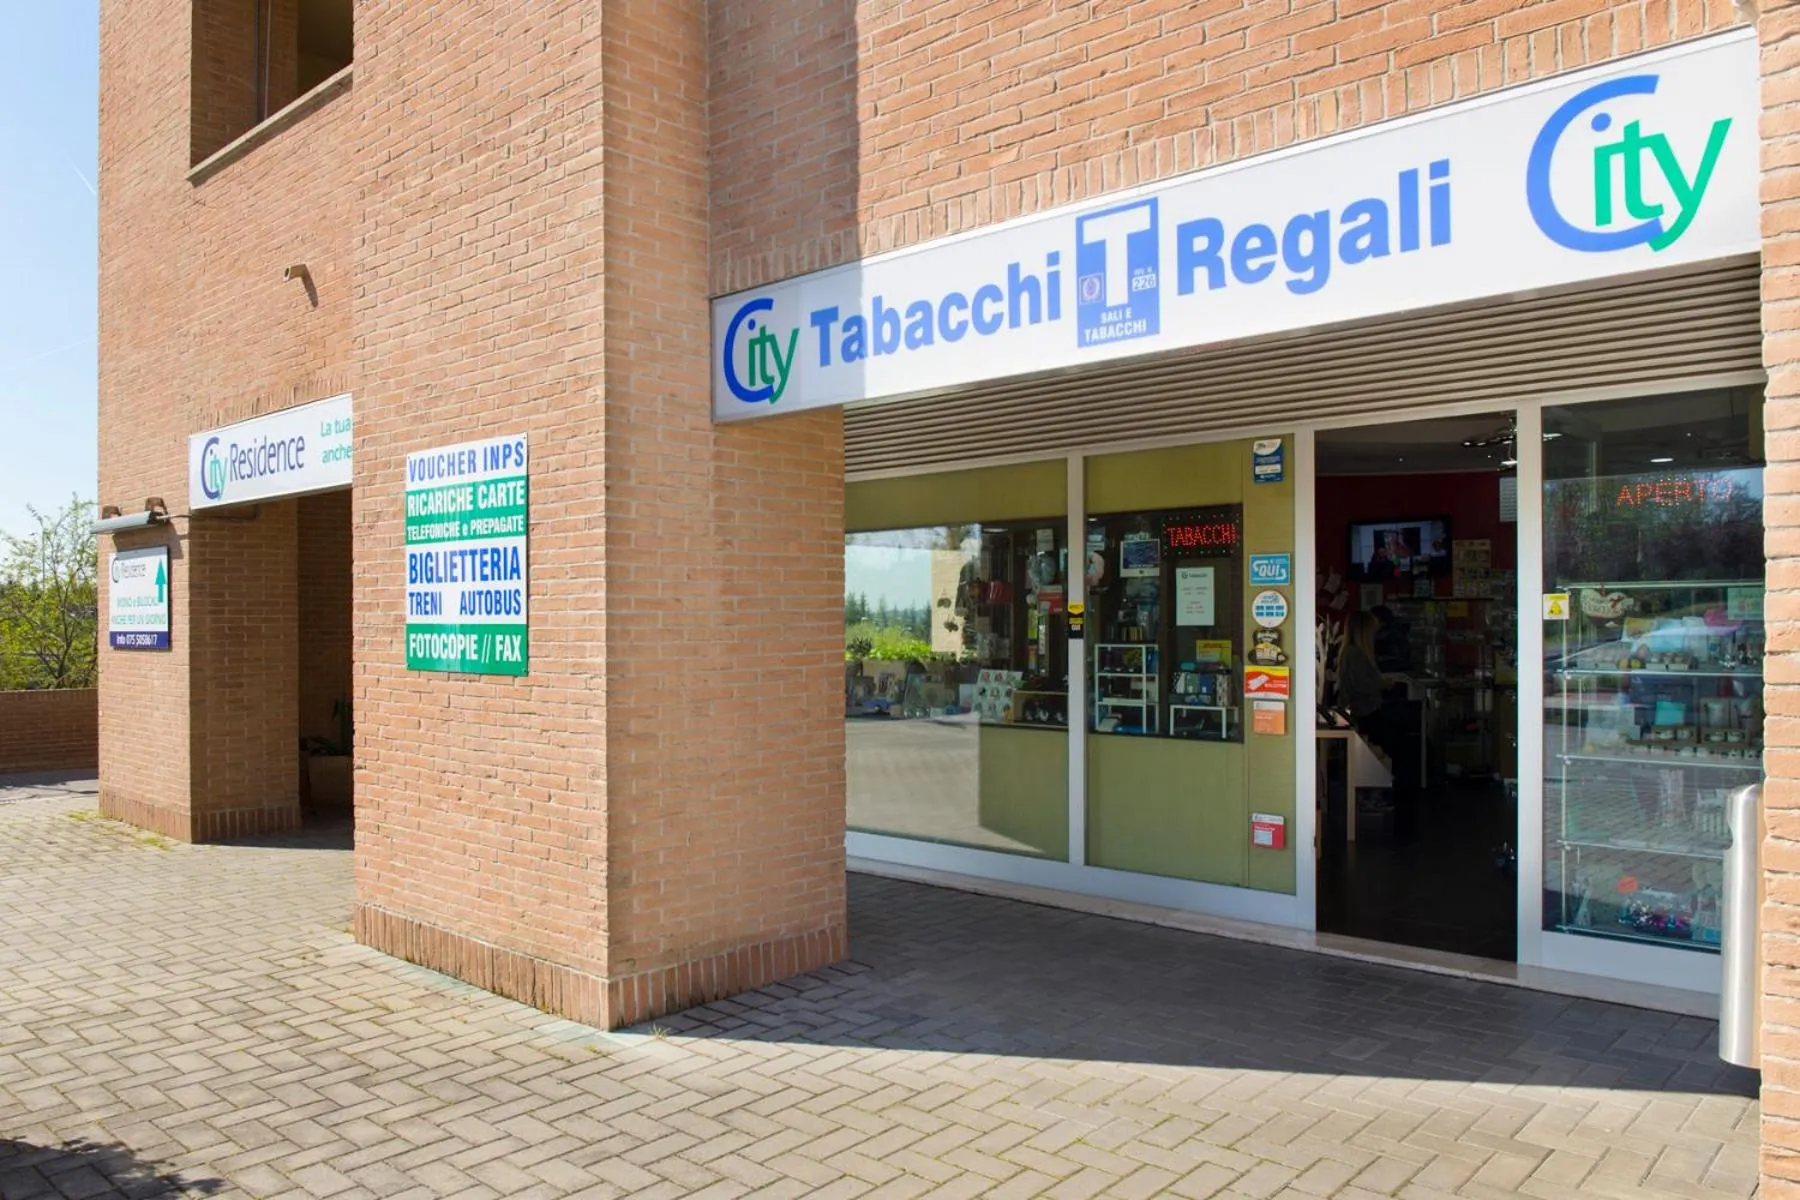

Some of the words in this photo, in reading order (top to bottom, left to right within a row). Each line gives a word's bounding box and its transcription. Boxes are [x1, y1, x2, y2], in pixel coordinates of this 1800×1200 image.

[1526, 74, 1734, 253] City
[1176, 158, 1452, 296] Regali
[1083, 205, 1151, 308] T
[810, 250, 1062, 367] Tabacchi
[1101, 311, 1123, 324] SALI
[1125, 307, 1133, 319] E
[1084, 318, 1147, 343] TABACCHI
[723, 298, 800, 405] City
[320, 421, 333, 437] La
[333, 417, 351, 433] tua
[201, 436, 229, 500] City
[230, 434, 306, 482] Residence
[321, 445, 352, 464] anche
[409, 449, 477, 482] VOUCHER
[483, 441, 525, 472] INPS
[407, 486, 474, 517] RICARICHE
[477, 480, 526, 510] CARTE
[1616, 479, 1733, 506] APERTO
[407, 521, 460, 541] TELEFONICHE
[462, 523, 468, 537] e
[470, 515, 524, 536] PREPAGATE
[1167, 523, 1237, 547] TABACCHI
[409, 546, 521, 584] BIGLIETTERIA
[408, 591, 443, 616] TRENI
[459, 589, 522, 617] AUTOBUS
[409, 632, 478, 660] FOTOCOPIE
[495, 634, 522, 662] FAX
